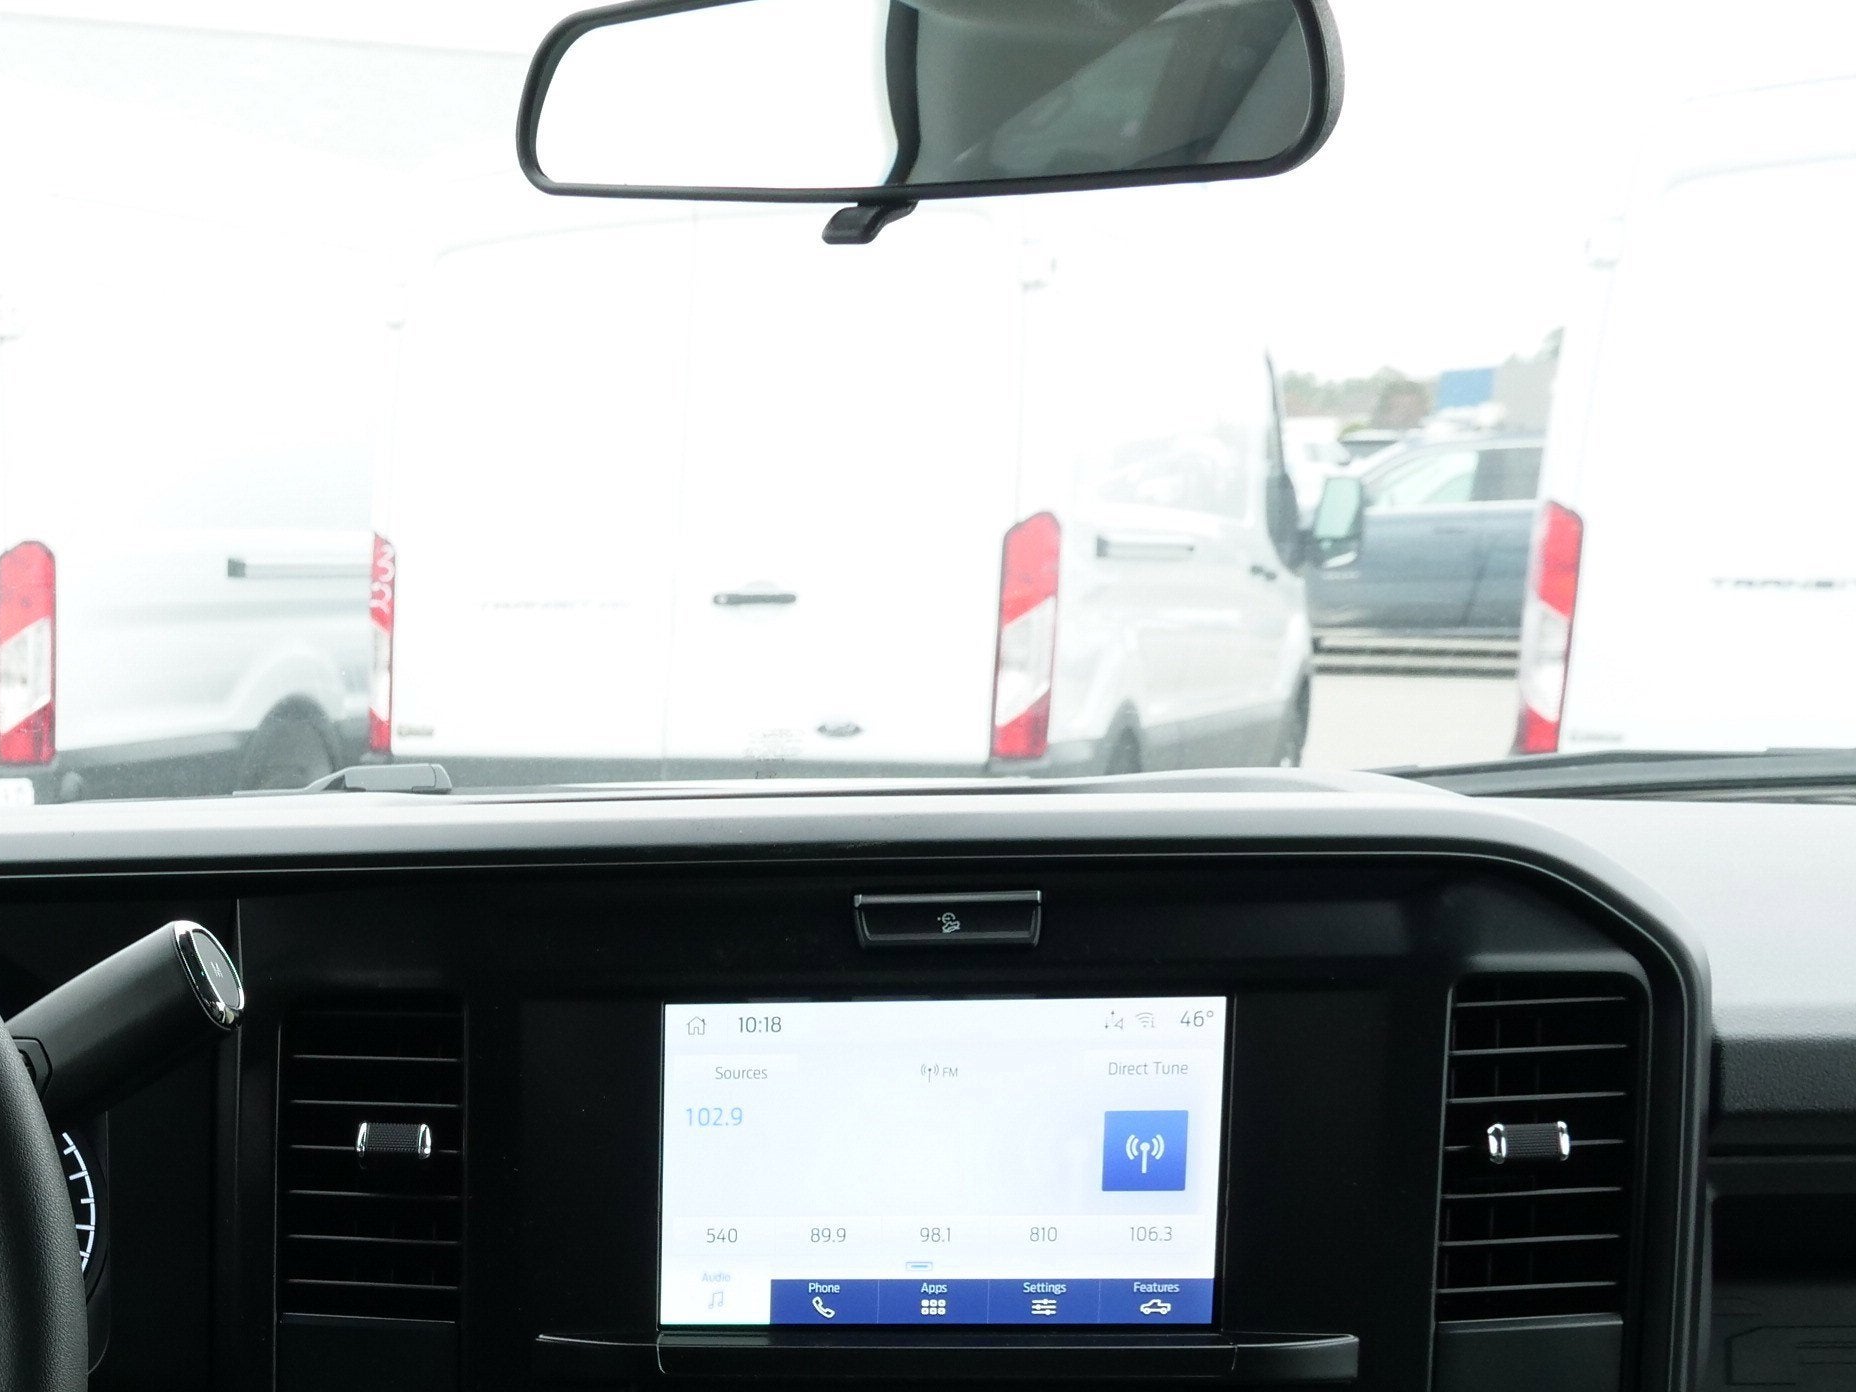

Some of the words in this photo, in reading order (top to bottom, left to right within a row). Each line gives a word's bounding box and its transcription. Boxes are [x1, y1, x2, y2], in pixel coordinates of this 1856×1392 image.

[737, 1016, 782, 1033] 10:18
[1180, 1010, 1214, 1028] 46°
[715, 1066, 768, 1080] Sources
[941, 1067, 958, 1077] FM
[1108, 1062, 1148, 1076] Direct
[1152, 1061, 1189, 1075] Tune
[685, 1107, 743, 1127] 102.9
[706, 1228, 738, 1243] 540
[810, 1228, 846, 1243] 89.9
[920, 1227, 951, 1243] 98.1
[1029, 1226, 1058, 1242] 810
[1129, 1226, 1173, 1242] 106.3
[701, 1272, 731, 1282] Audio
[808, 1282, 840, 1294] Phone
[921, 1282, 948, 1295] Apps
[1023, 1282, 1067, 1295] Settings
[1133, 1282, 1180, 1293] Features
